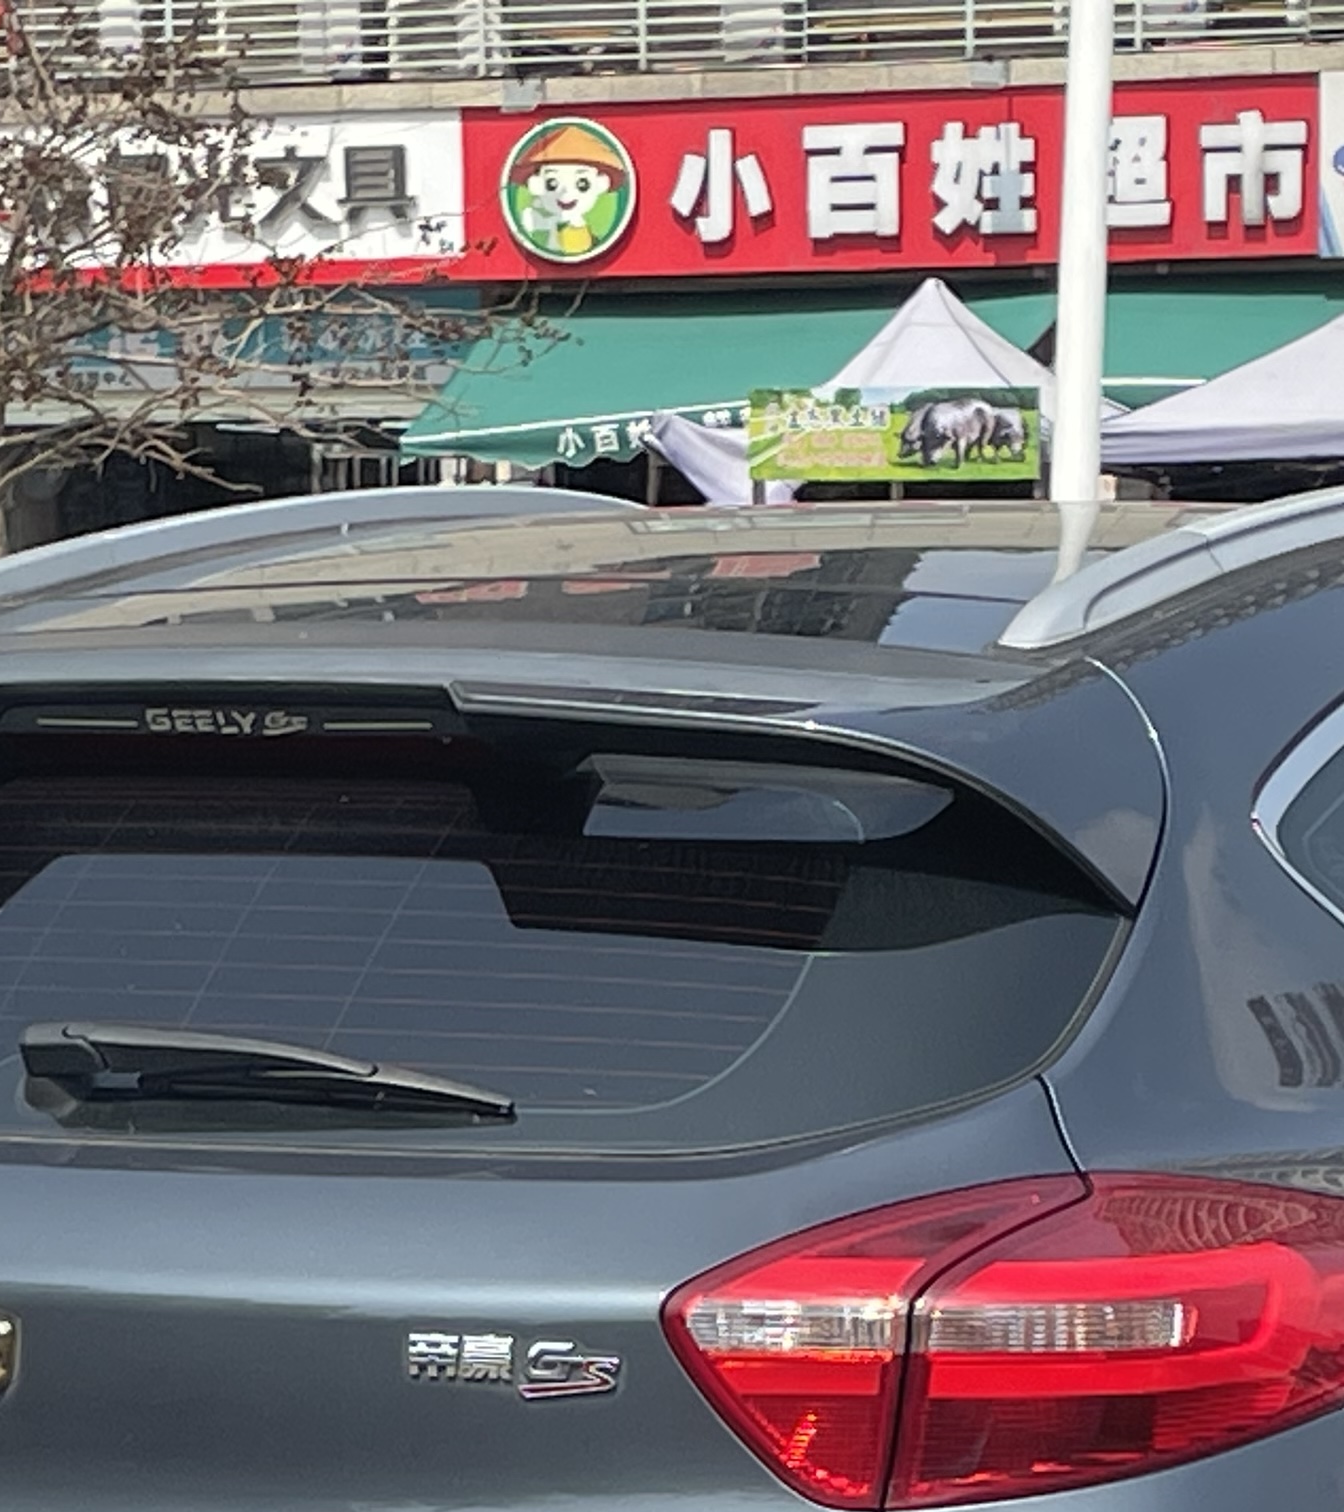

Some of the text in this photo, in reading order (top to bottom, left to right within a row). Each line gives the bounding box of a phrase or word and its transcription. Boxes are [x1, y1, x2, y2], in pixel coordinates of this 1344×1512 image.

[669, 109, 1309, 243] 小百姓超市
[145, 707, 256, 734] GEELY
